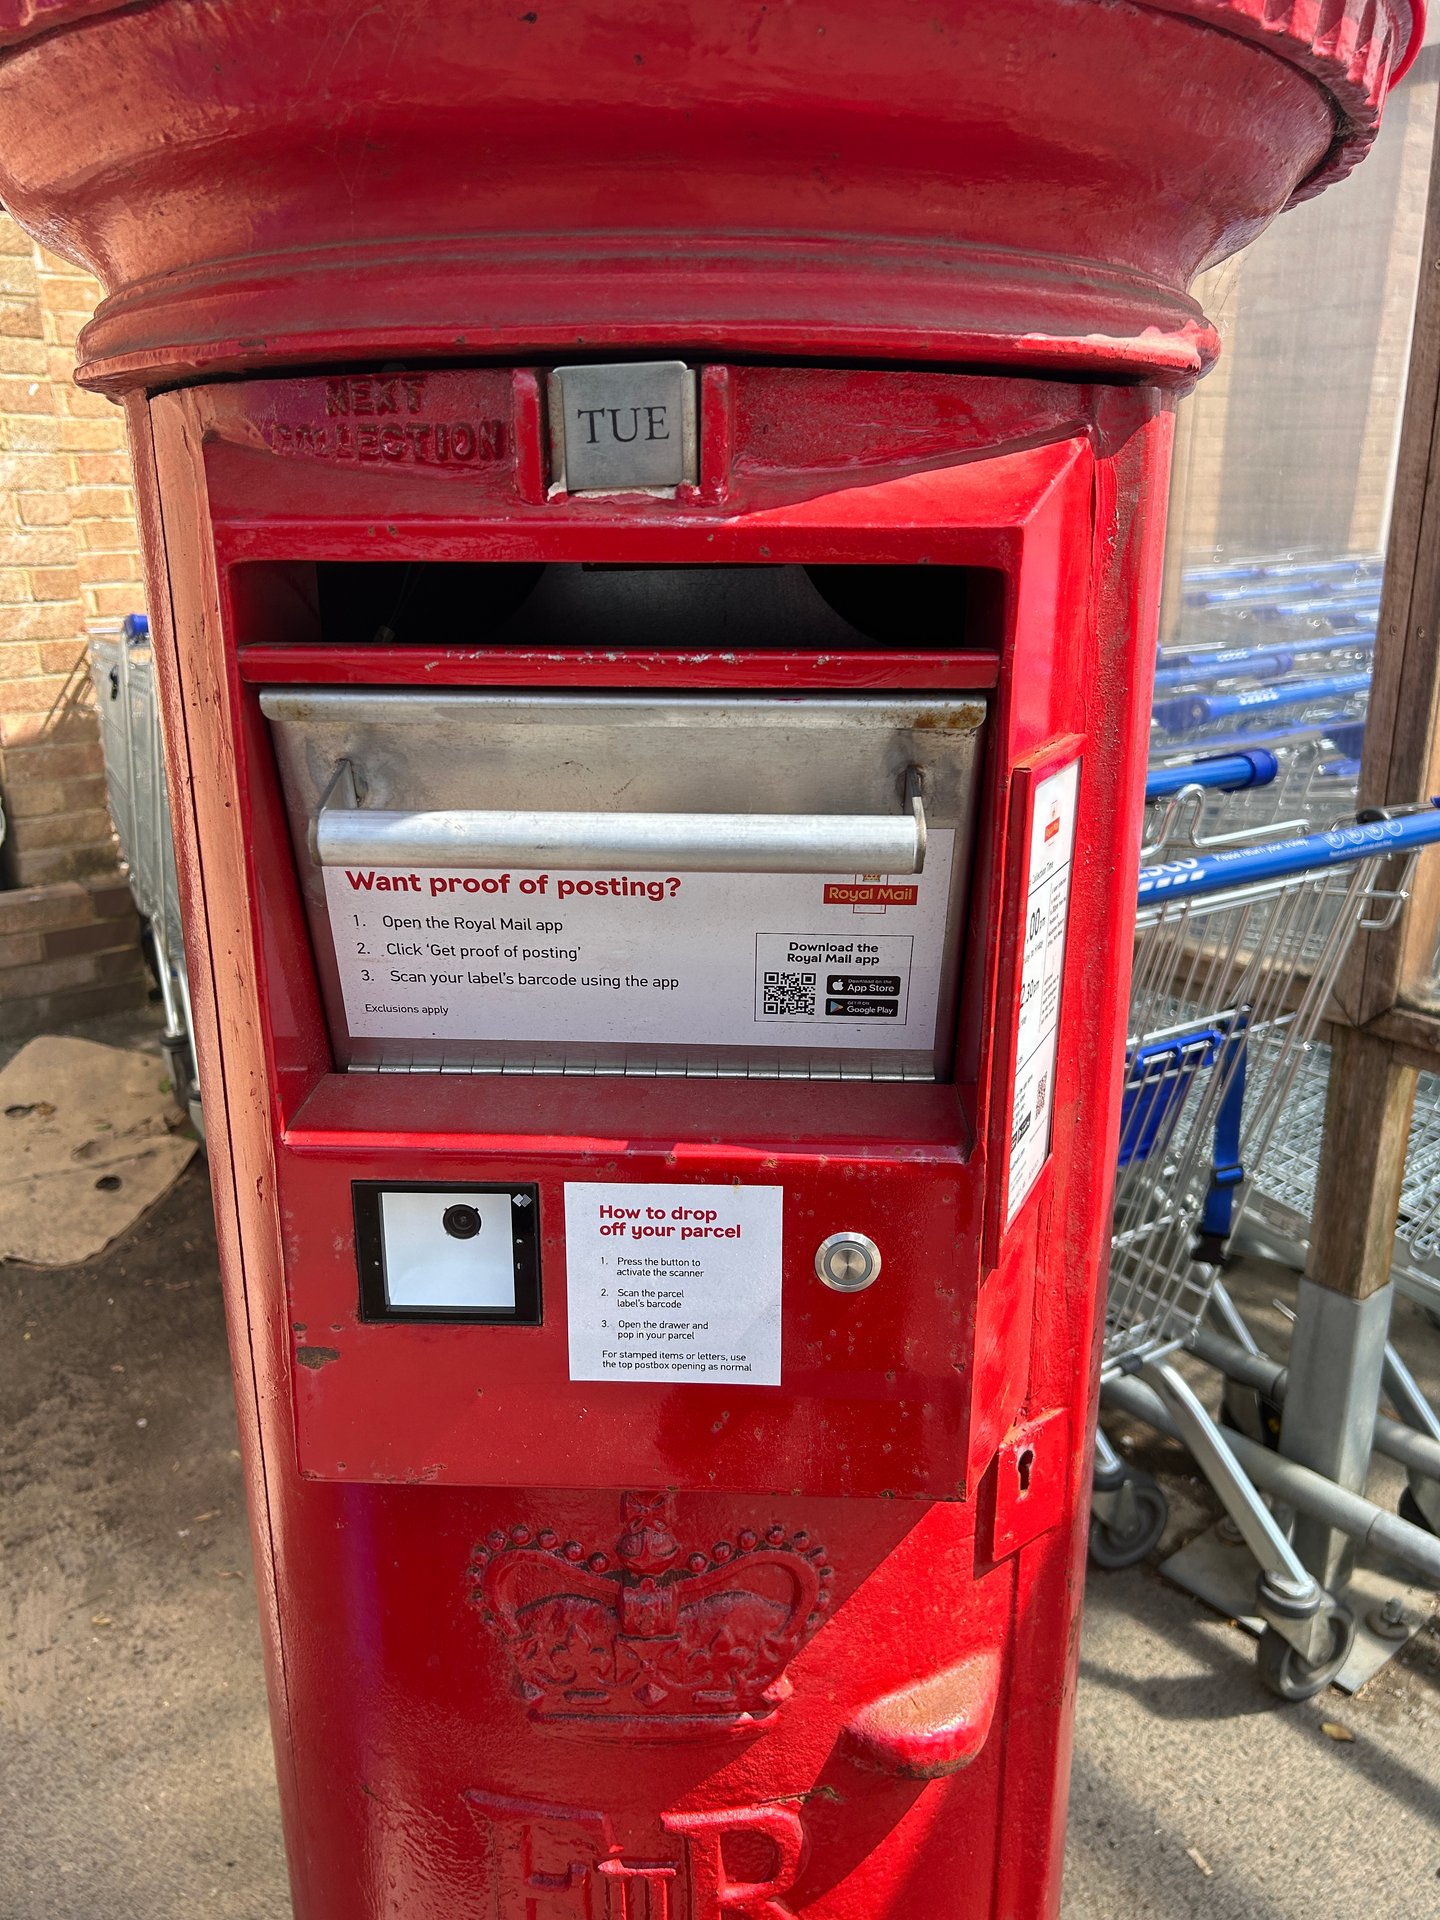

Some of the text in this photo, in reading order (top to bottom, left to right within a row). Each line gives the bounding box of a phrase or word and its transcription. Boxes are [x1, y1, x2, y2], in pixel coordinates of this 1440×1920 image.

[326, 378, 426, 416] NEXT
[577, 405, 670, 444] TUE
[1138, 856, 1199, 880] SCO
[345, 871, 681, 901] Want proof of posting?
[829, 886, 912, 902] Royal Mail
[354, 915, 562, 934] 1. Open the Royal Mail app
[357, 942, 580, 961] 2. Click ‘Get proof of posting’
[790, 942, 878, 952] Download the
[788, 953, 879, 966] Royal Mail app
[361, 970, 678, 990] 3. Scan your label’s barcode using the app
[847, 984, 895, 993] App Store
[365, 1004, 448, 1016] Exclusions apply
[847, 1005, 894, 1015] Google Play
[600, 1205, 717, 1223] How to drop
[600, 1222, 740, 1240] off your parcel
[601, 1257, 608, 1265] 1.
[618, 1257, 642, 1265] Press
[661, 1258, 689, 1266] button
[653, 1268, 667, 1276] the
[601, 1288, 684, 1299] 2. Scan the parcel
[618, 1299, 681, 1308] label’s barcode
[619, 1320, 640, 1329] Open
[644, 1320, 657, 1328] the
[659, 1321, 690, 1329] drawer
[618, 1332, 634, 1340] pop
[668, 1332, 694, 1341] parcel
[603, 1350, 617, 1358] For
[620, 1351, 657, 1360] stamped
[698, 1352, 728, 1361] letters,
[635, 1361, 669, 1370] postbox
[672, 1364, 705, 1372] opening
